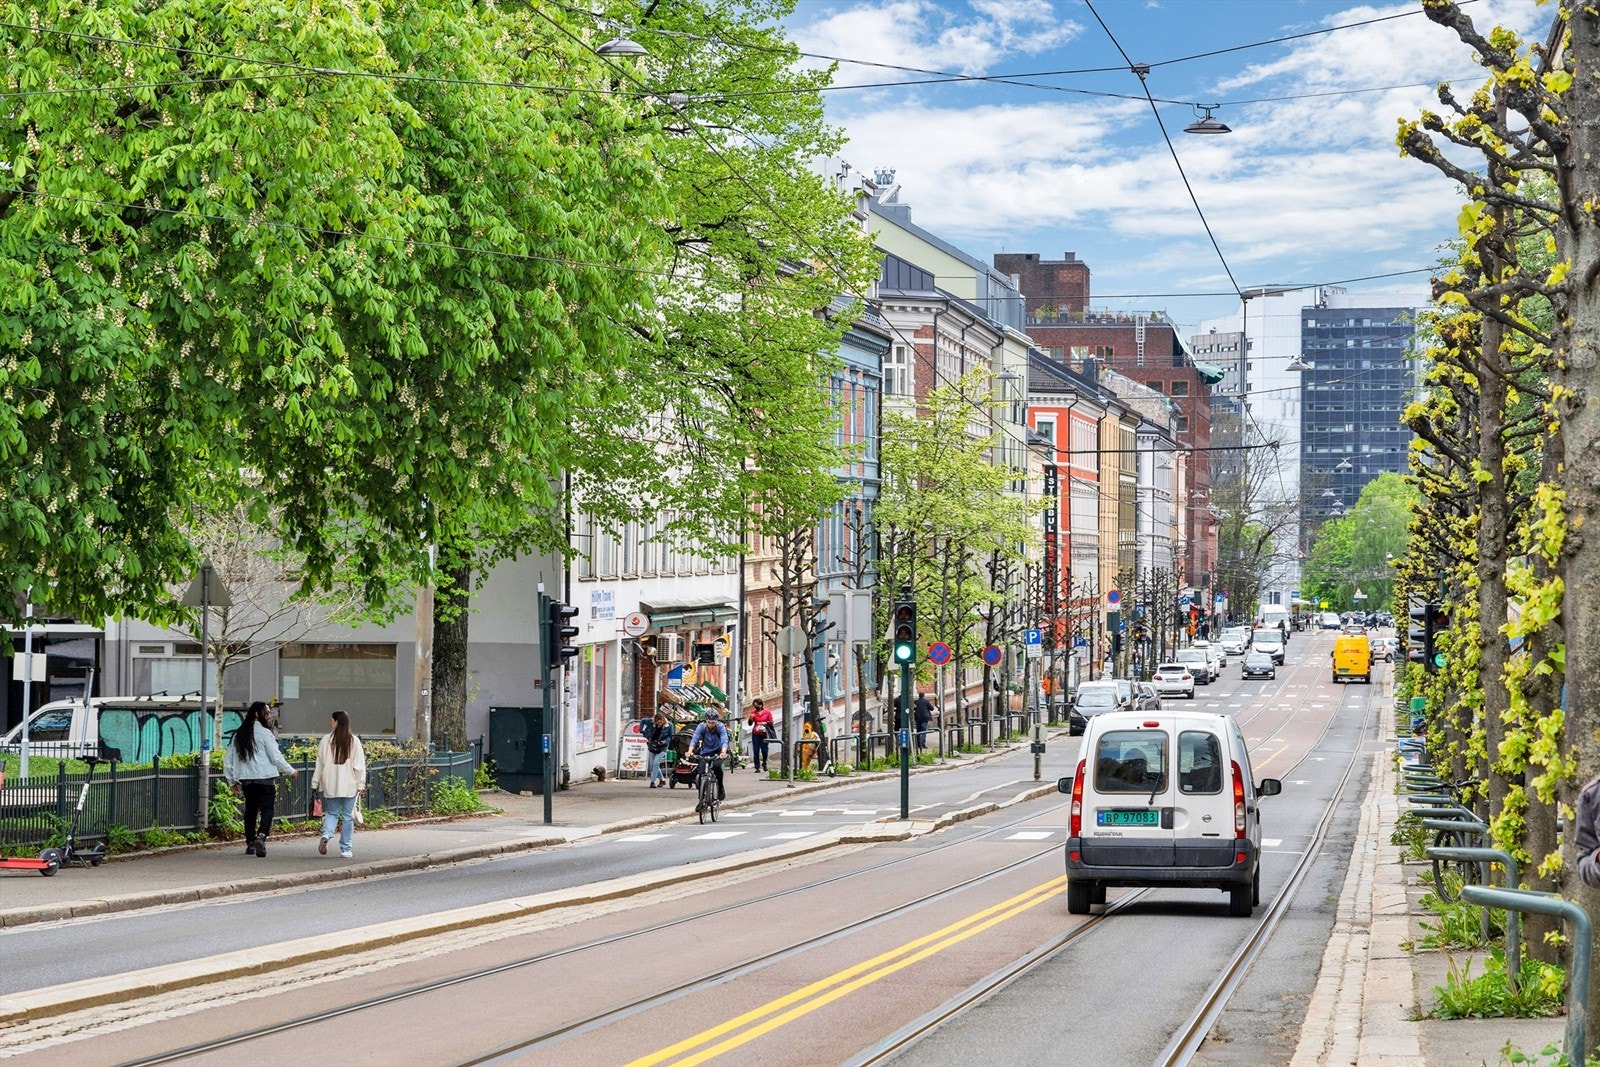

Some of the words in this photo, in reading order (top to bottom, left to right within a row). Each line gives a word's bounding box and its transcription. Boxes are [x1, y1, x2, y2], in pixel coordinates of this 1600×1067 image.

[1029, 631, 1037, 643] P
[1106, 813, 1119, 822] BP
[1123, 812, 1155, 822] 97083
